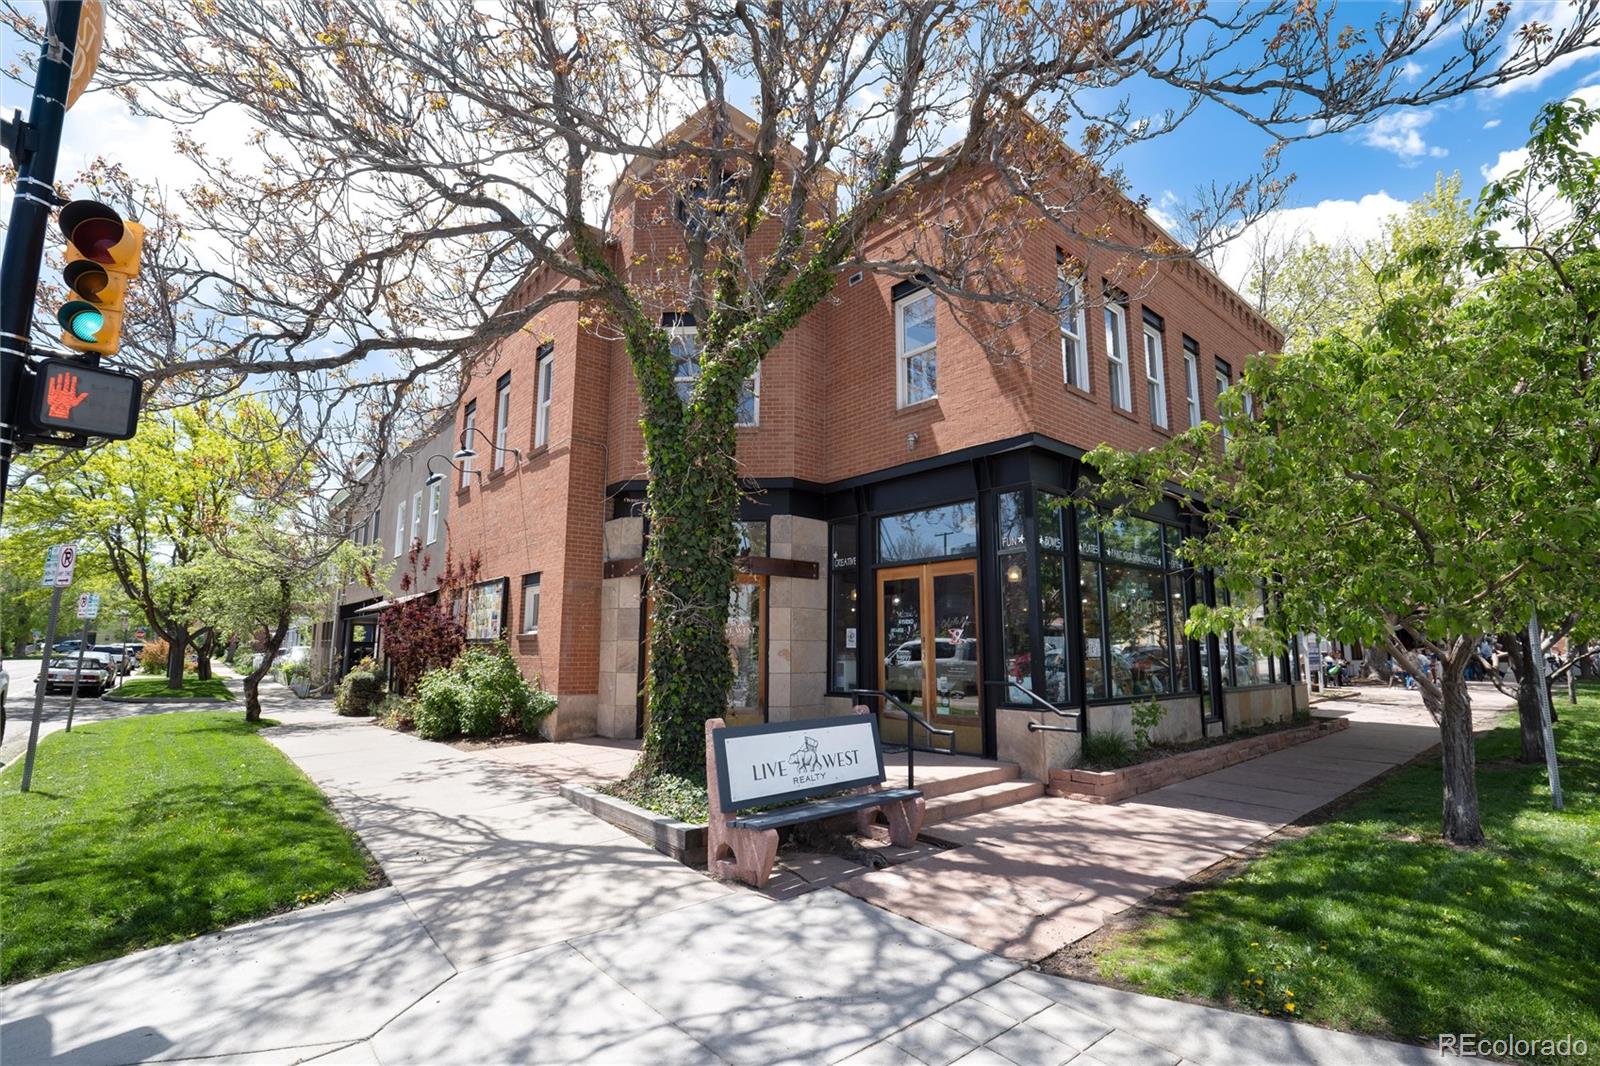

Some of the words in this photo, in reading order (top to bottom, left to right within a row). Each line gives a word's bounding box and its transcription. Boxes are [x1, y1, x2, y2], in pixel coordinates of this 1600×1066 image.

[1002, 536, 1017, 547] FUN
[834, 556, 857, 568] CREATIVE
[752, 760, 788, 781] LIVE
[822, 749, 859, 768] WEST
[793, 772, 826, 785] REALTY
